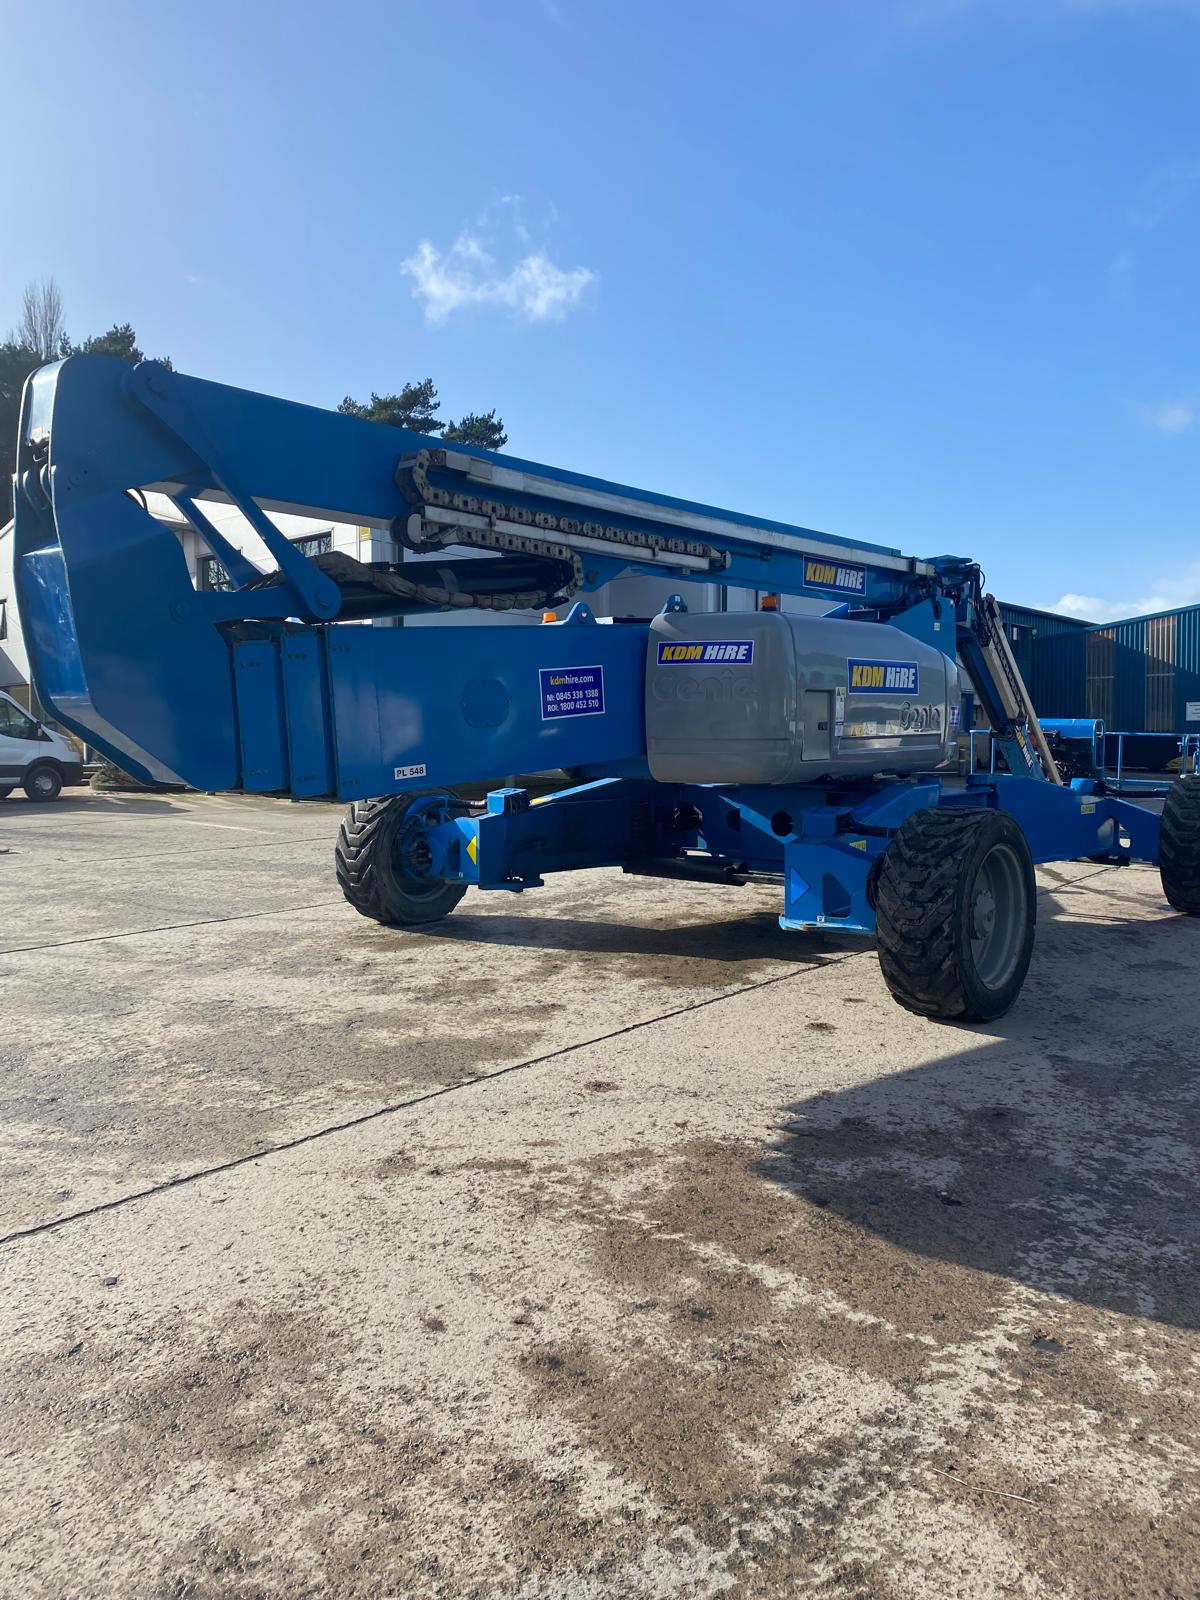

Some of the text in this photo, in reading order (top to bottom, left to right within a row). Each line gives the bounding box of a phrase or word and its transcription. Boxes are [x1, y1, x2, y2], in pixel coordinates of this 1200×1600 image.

[806, 562, 836, 584] KDM
[661, 646, 704, 660] KDM
[550, 674, 594, 685] kdmhire.com
[852, 665, 885, 687] KDM
[555, 691, 571, 701] 0845
[572, 690, 583, 699] 338
[560, 701, 575, 711] 1800
[575, 700, 587, 709] 452
[588, 699, 599, 708] 510
[396, 766, 424, 778] PL 548
